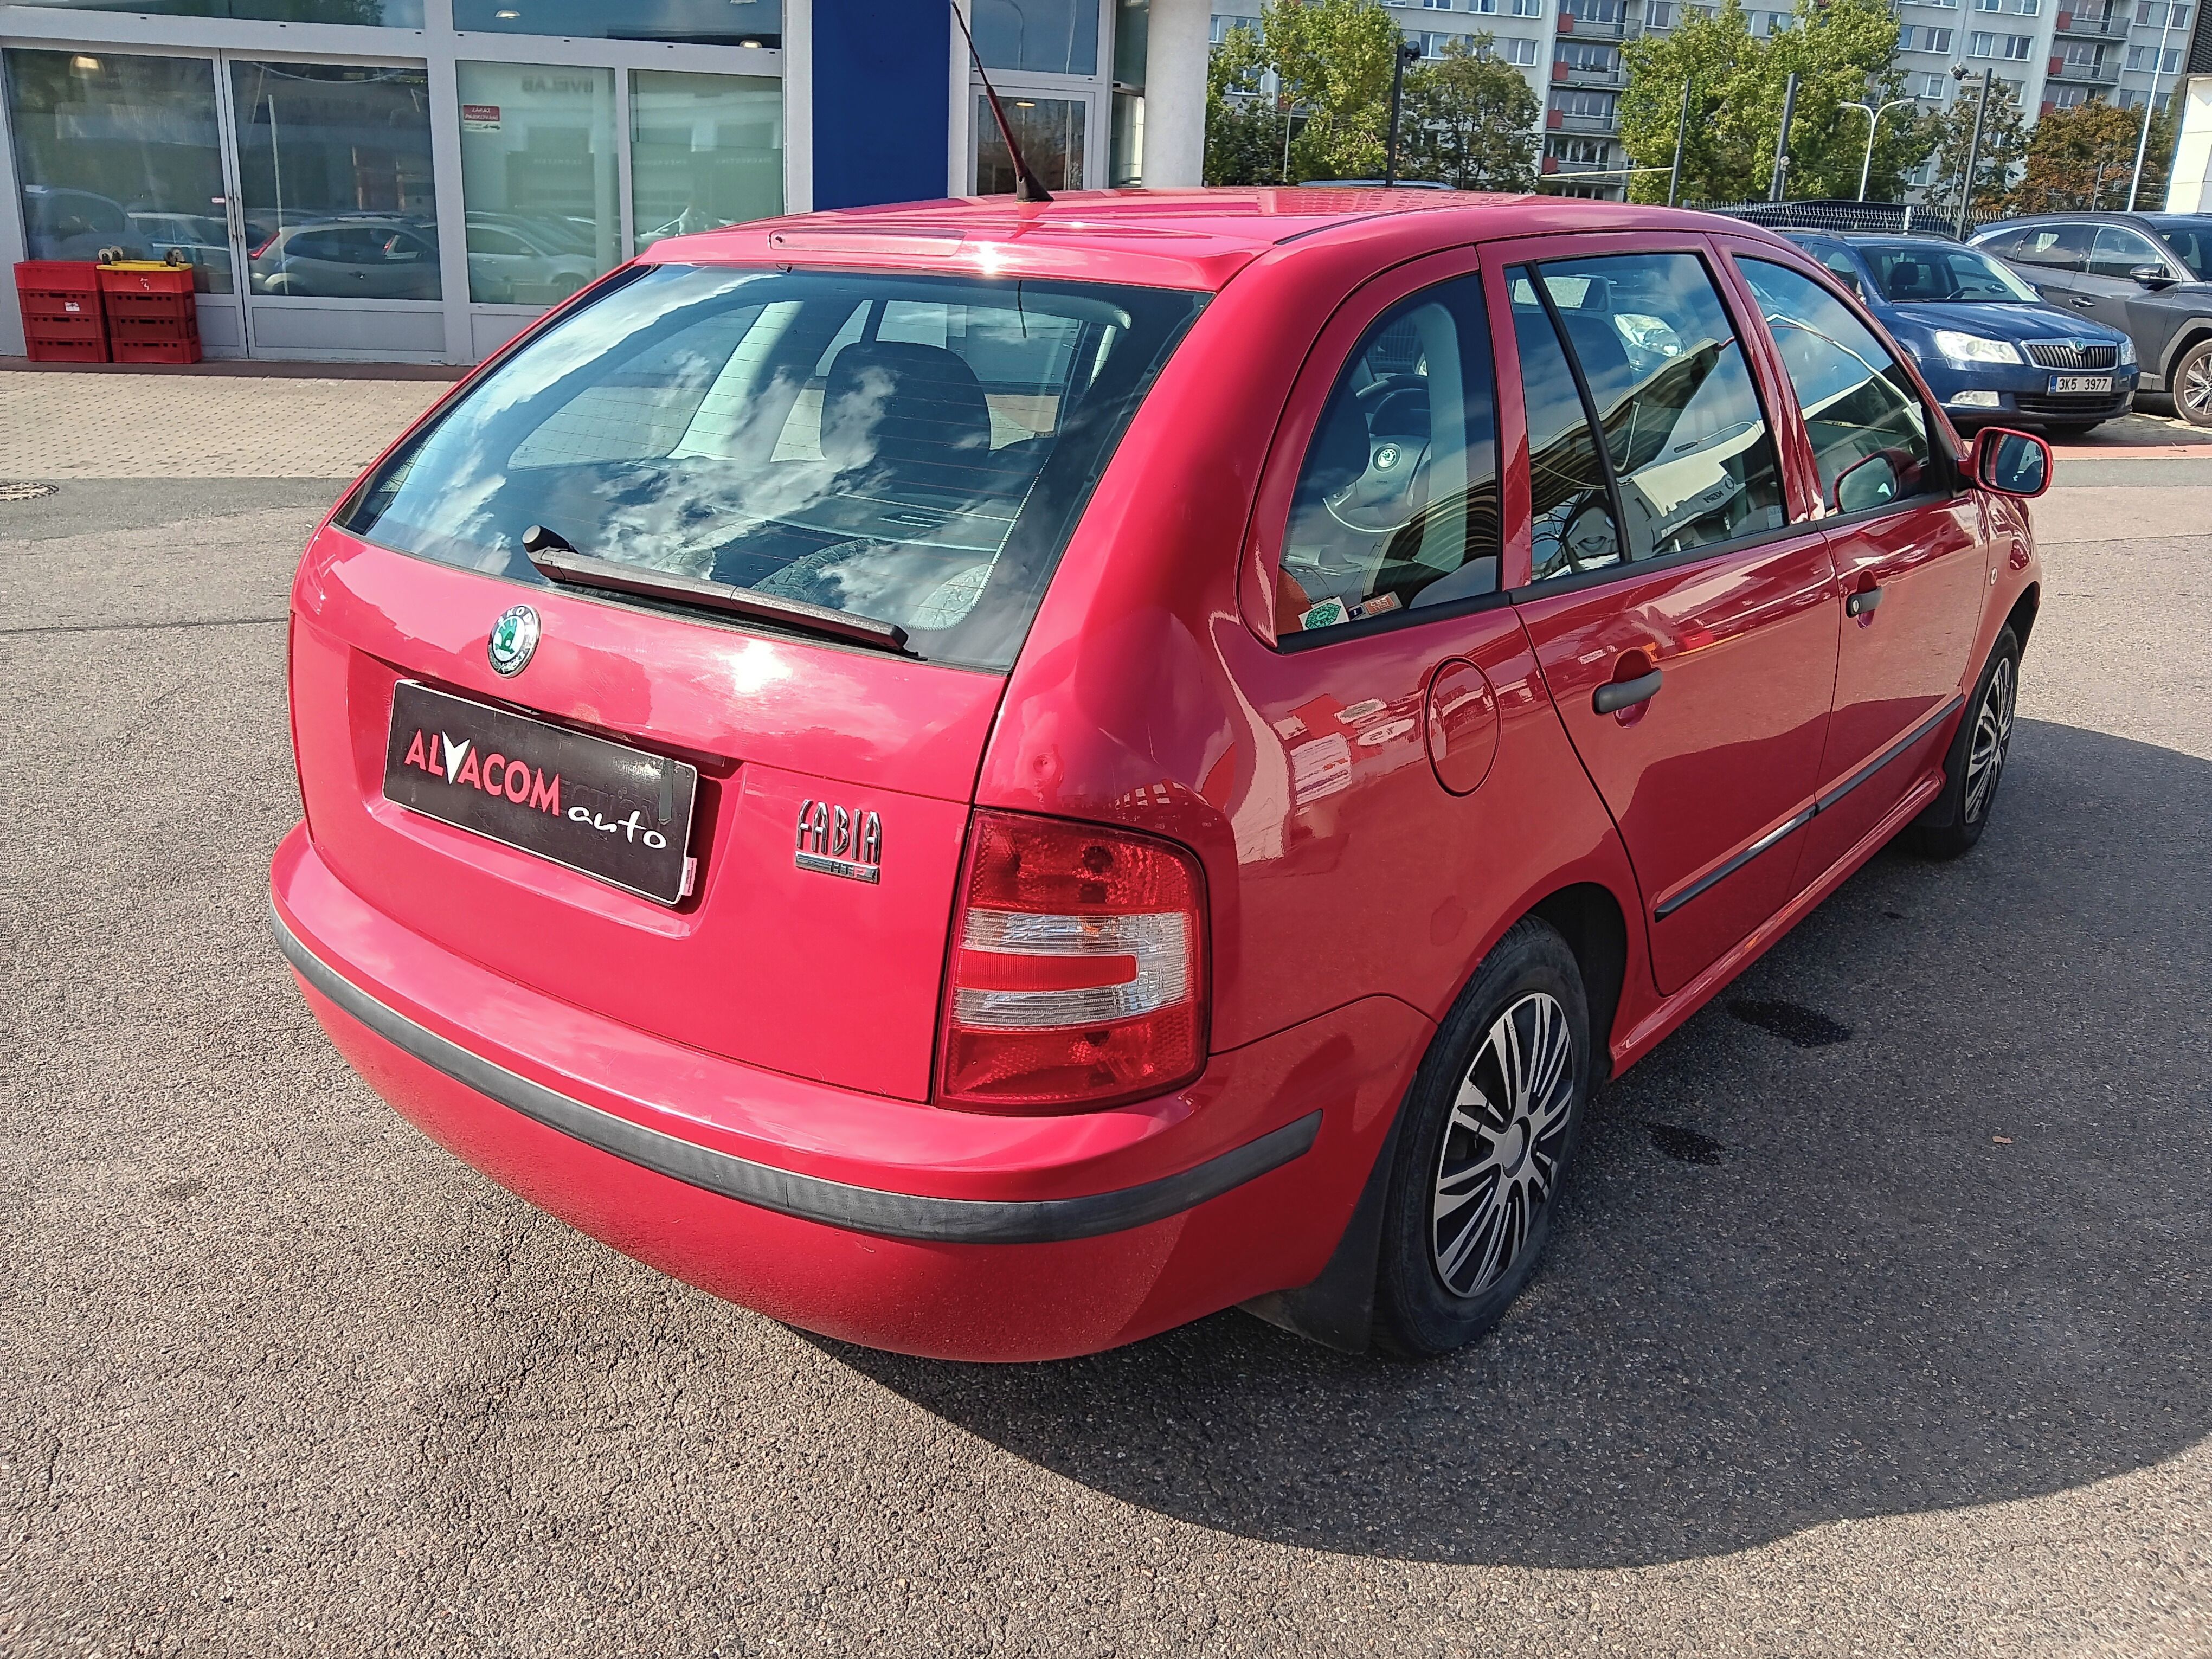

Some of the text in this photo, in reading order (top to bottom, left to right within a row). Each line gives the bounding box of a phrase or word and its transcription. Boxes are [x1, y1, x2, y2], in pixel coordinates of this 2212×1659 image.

[2059, 378, 2078, 390] 3K5
[2084, 378, 2108, 390] 3977
[404, 728, 560, 816] ALVACOM
[568, 806, 667, 849] auto
[796, 799, 880, 864] FABIA
